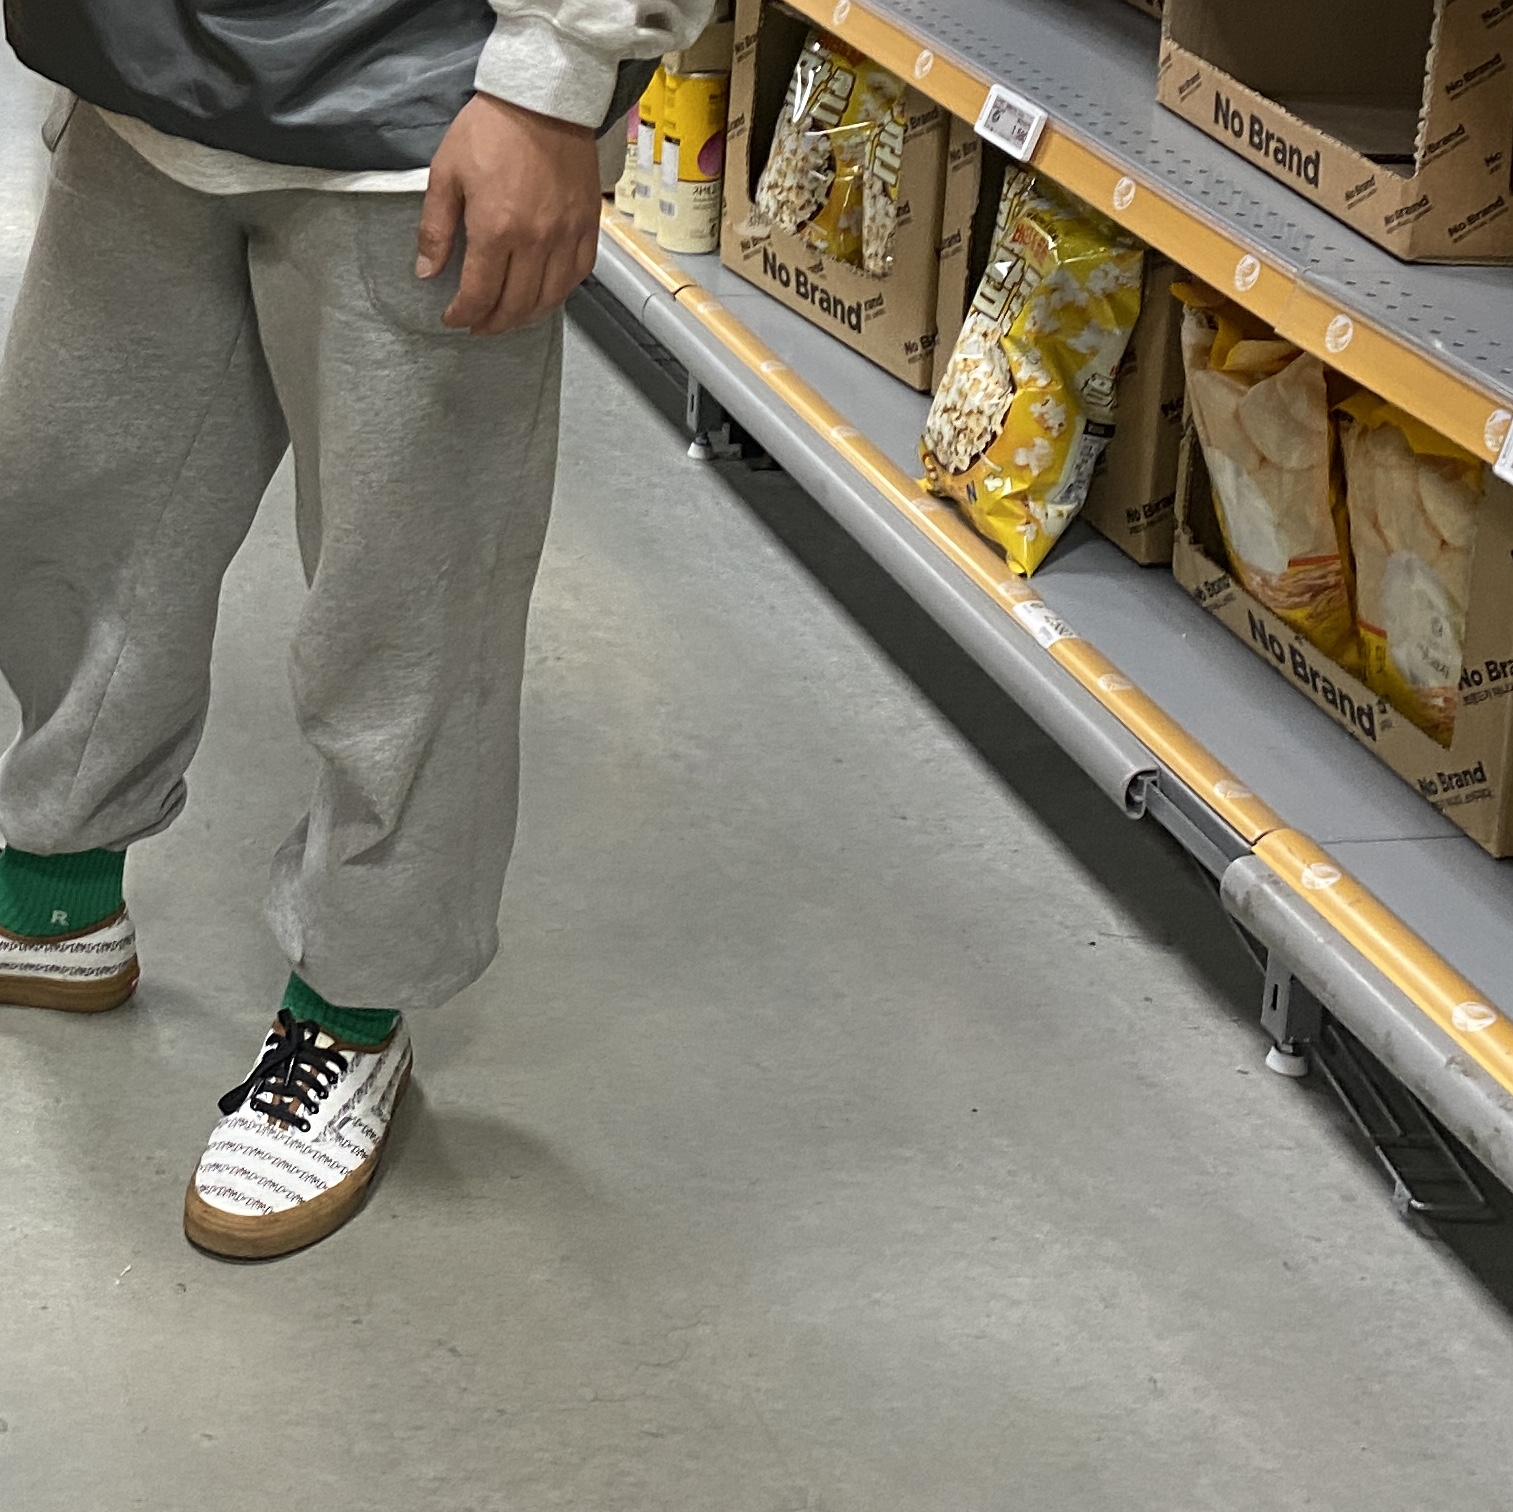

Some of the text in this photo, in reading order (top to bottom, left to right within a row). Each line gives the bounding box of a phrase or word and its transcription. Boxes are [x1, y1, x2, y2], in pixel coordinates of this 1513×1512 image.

[1463, 52, 1503, 82] Brand
[1213, 90, 1322, 189] No Brand
[1427, 123, 1465, 154] Brand
[1448, 195, 1505, 238] No Brand
[762, 246, 863, 334] No Brand
[1248, 608, 1377, 742] No Brand
[1458, 659, 1513, 691] No Bra
[1417, 761, 1487, 796] No Brand
[50, 909, 70, 927] R
